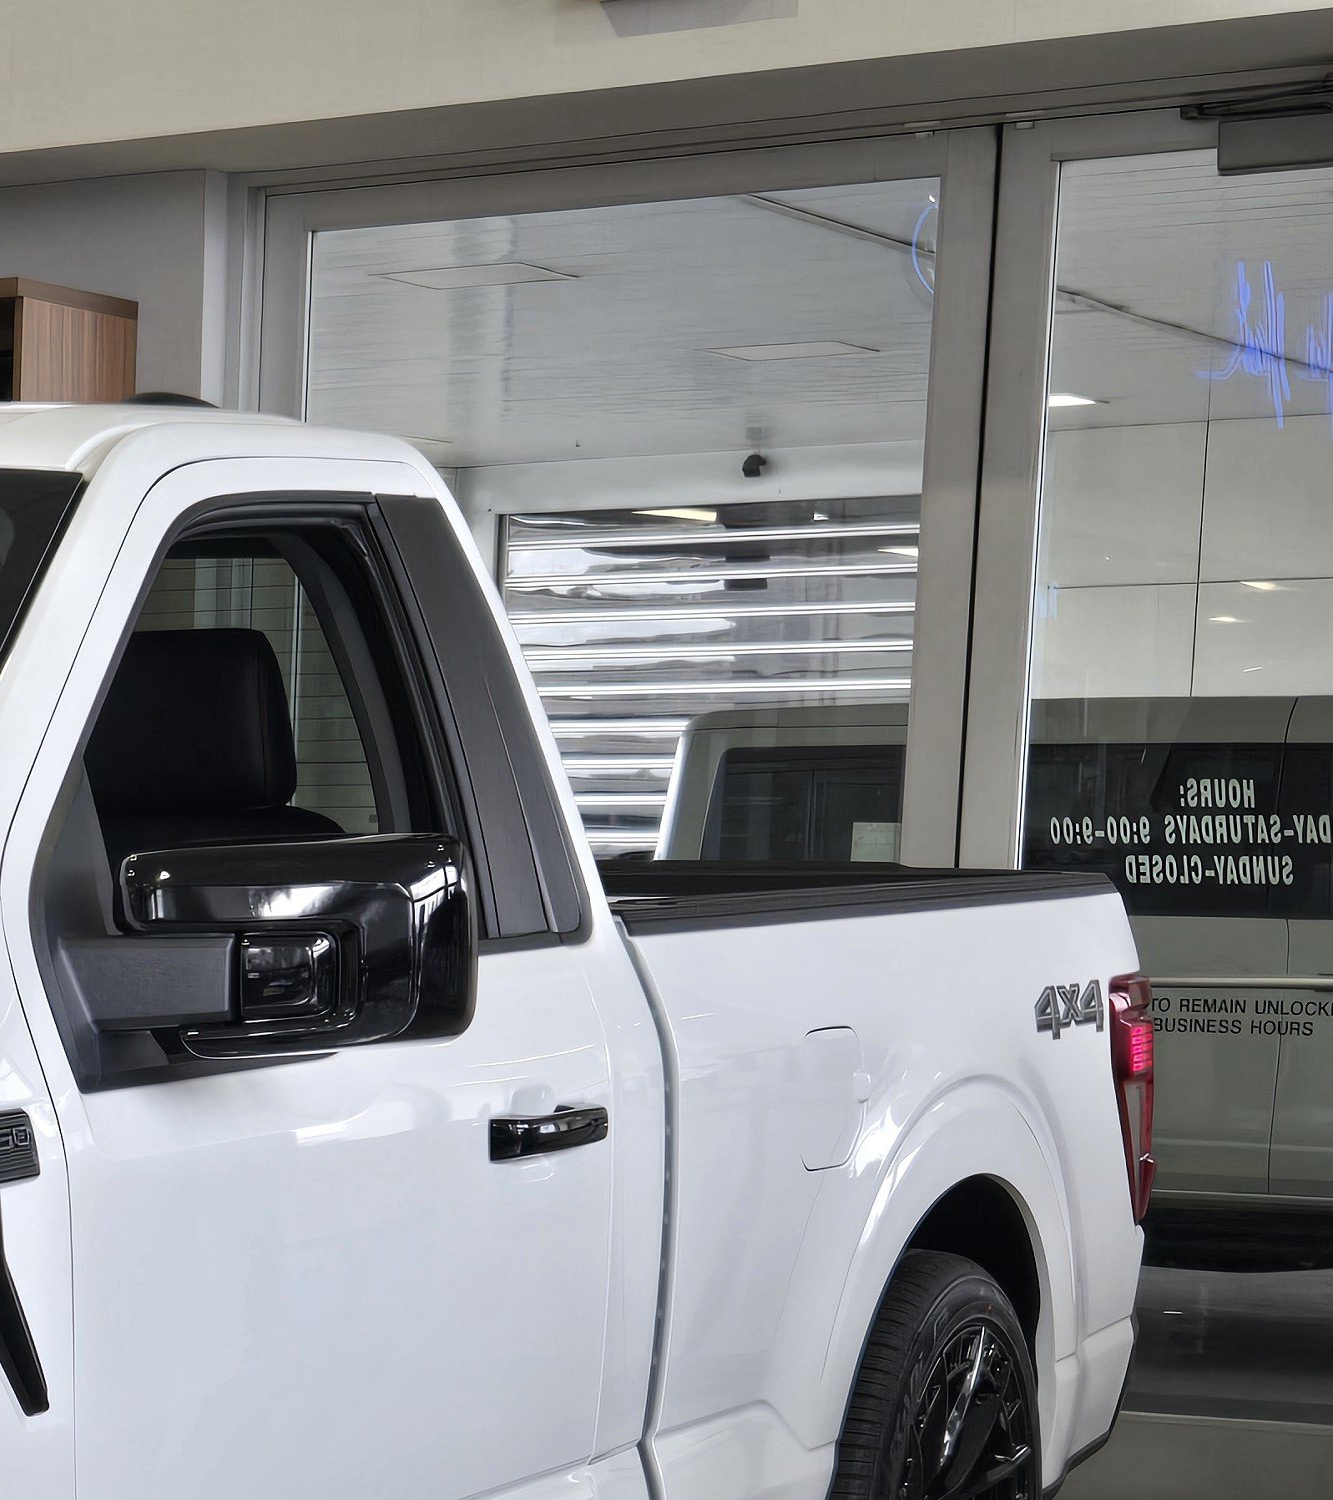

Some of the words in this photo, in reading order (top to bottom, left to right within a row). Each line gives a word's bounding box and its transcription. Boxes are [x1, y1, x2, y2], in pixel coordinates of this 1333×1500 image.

[1034, 979, 1104, 1040] 4X4
[1151, 998, 1171, 1012] TO
[1179, 998, 1247, 1014] REMAIN
[1153, 1017, 1242, 1035] BUSINESS
[1250, 1020, 1314, 1036] HOURS
